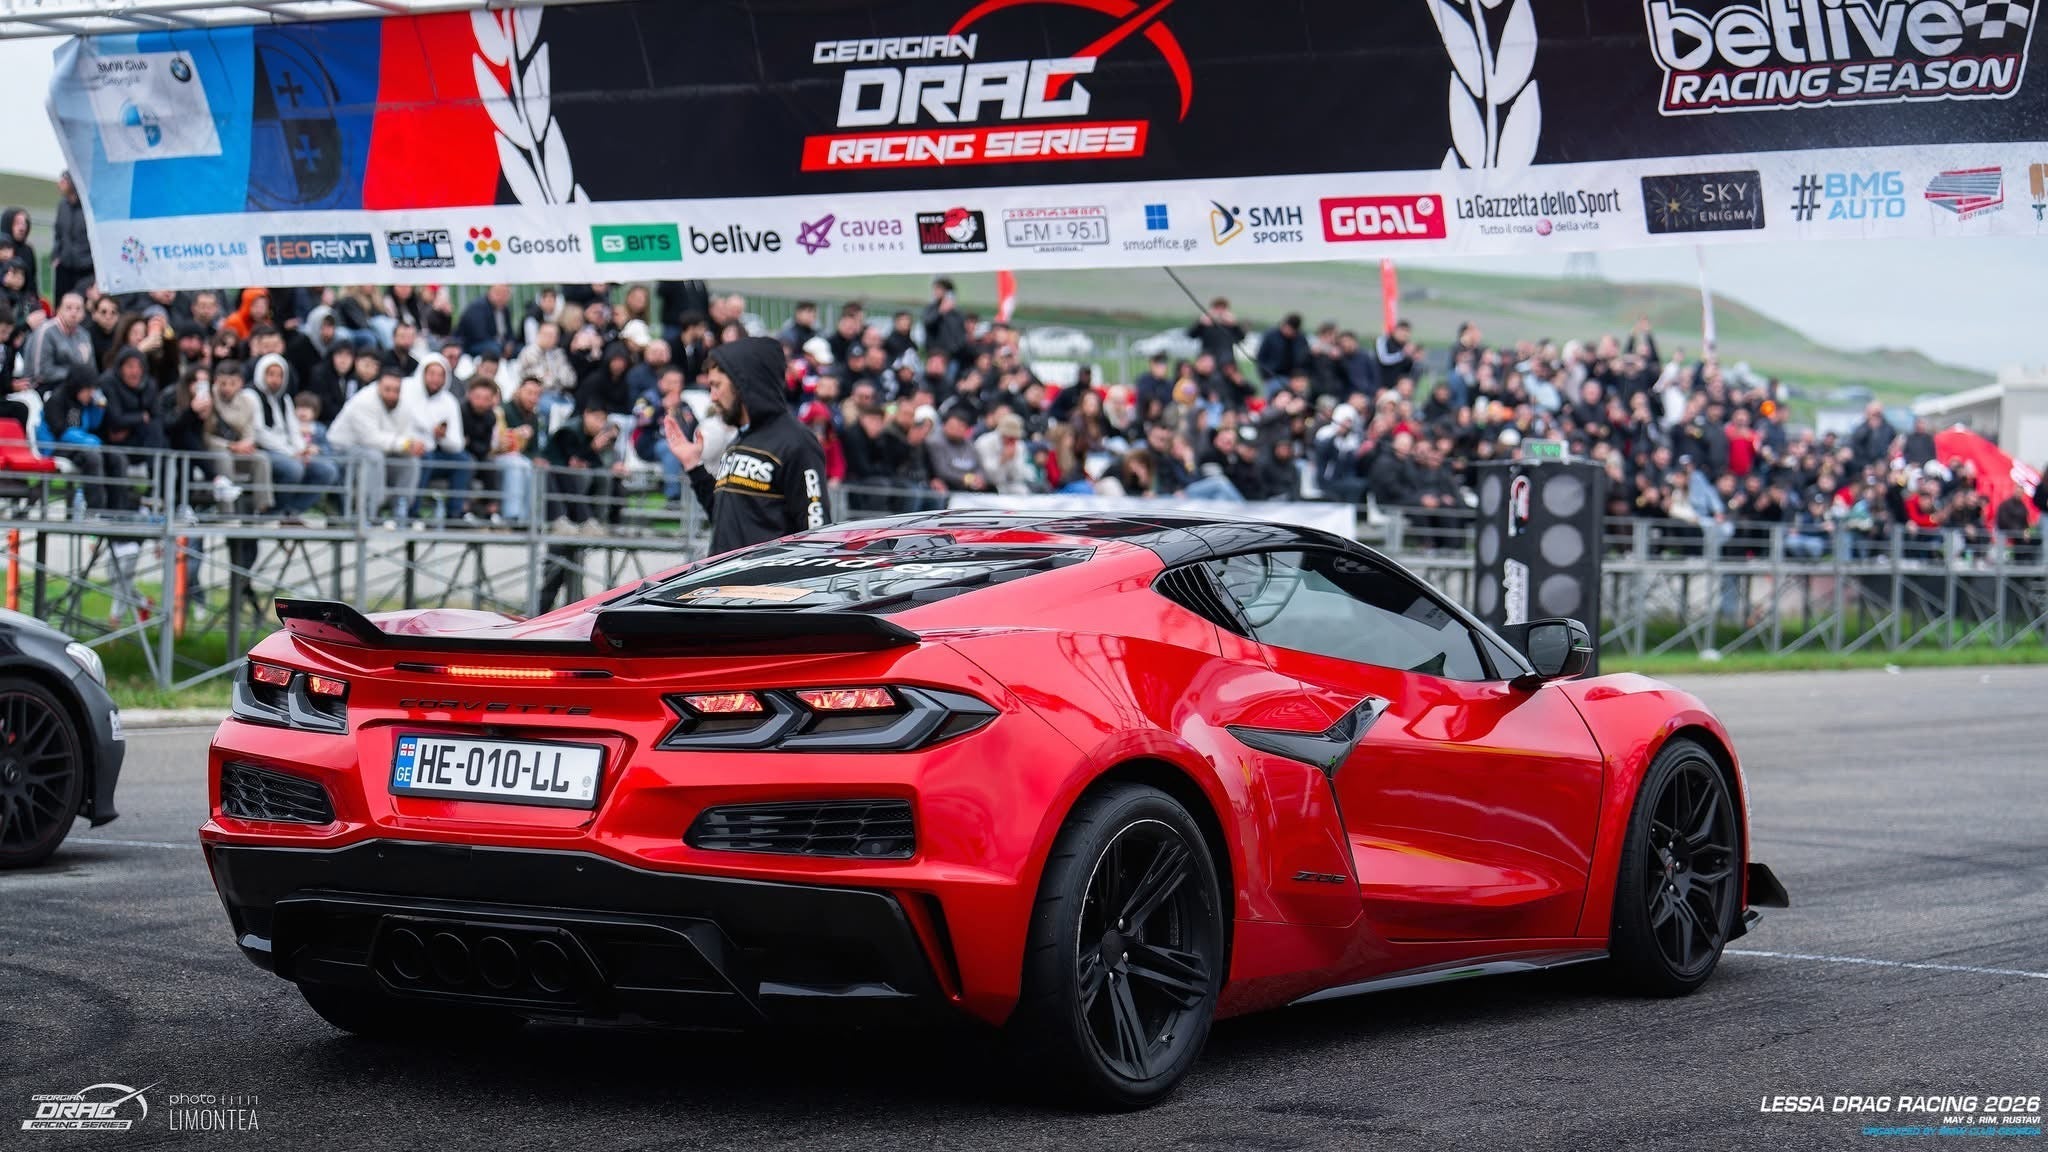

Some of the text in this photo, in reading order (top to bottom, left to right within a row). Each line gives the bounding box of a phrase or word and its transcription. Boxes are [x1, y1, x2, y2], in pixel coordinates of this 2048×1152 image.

[1651, 0, 1964, 70] betlive
[813, 33, 978, 64] GEORGIAN
[1671, 58, 2015, 104] RACING SEASON
[836, 56, 1097, 128] DRAG
[827, 126, 1138, 165] RACING SERIES
[1702, 182, 1747, 203] SKY
[1250, 206, 1303, 227] SMH
[1700, 208, 1753, 222] ENIGMA
[1827, 198, 1906, 220] AUTO
[840, 219, 902, 237] cavea
[1024, 221, 1100, 240] FM 95.1
[1330, 205, 1427, 236] GOAL
[507, 233, 580, 254] Geosoft
[627, 234, 671, 250] BITS
[689, 224, 781, 254] belive
[843, 242, 904, 252] CINEMAS
[1123, 236, 1197, 251] smsoffice.ge
[1253, 230, 1303, 244] SPORTS
[152, 242, 247, 259] TECHNO LAB
[266, 240, 369, 259] GEORENT
[400, 698, 593, 716] CORVETTE
[396, 767, 411, 782] GE
[416, 743, 570, 793] HE-010-LL
